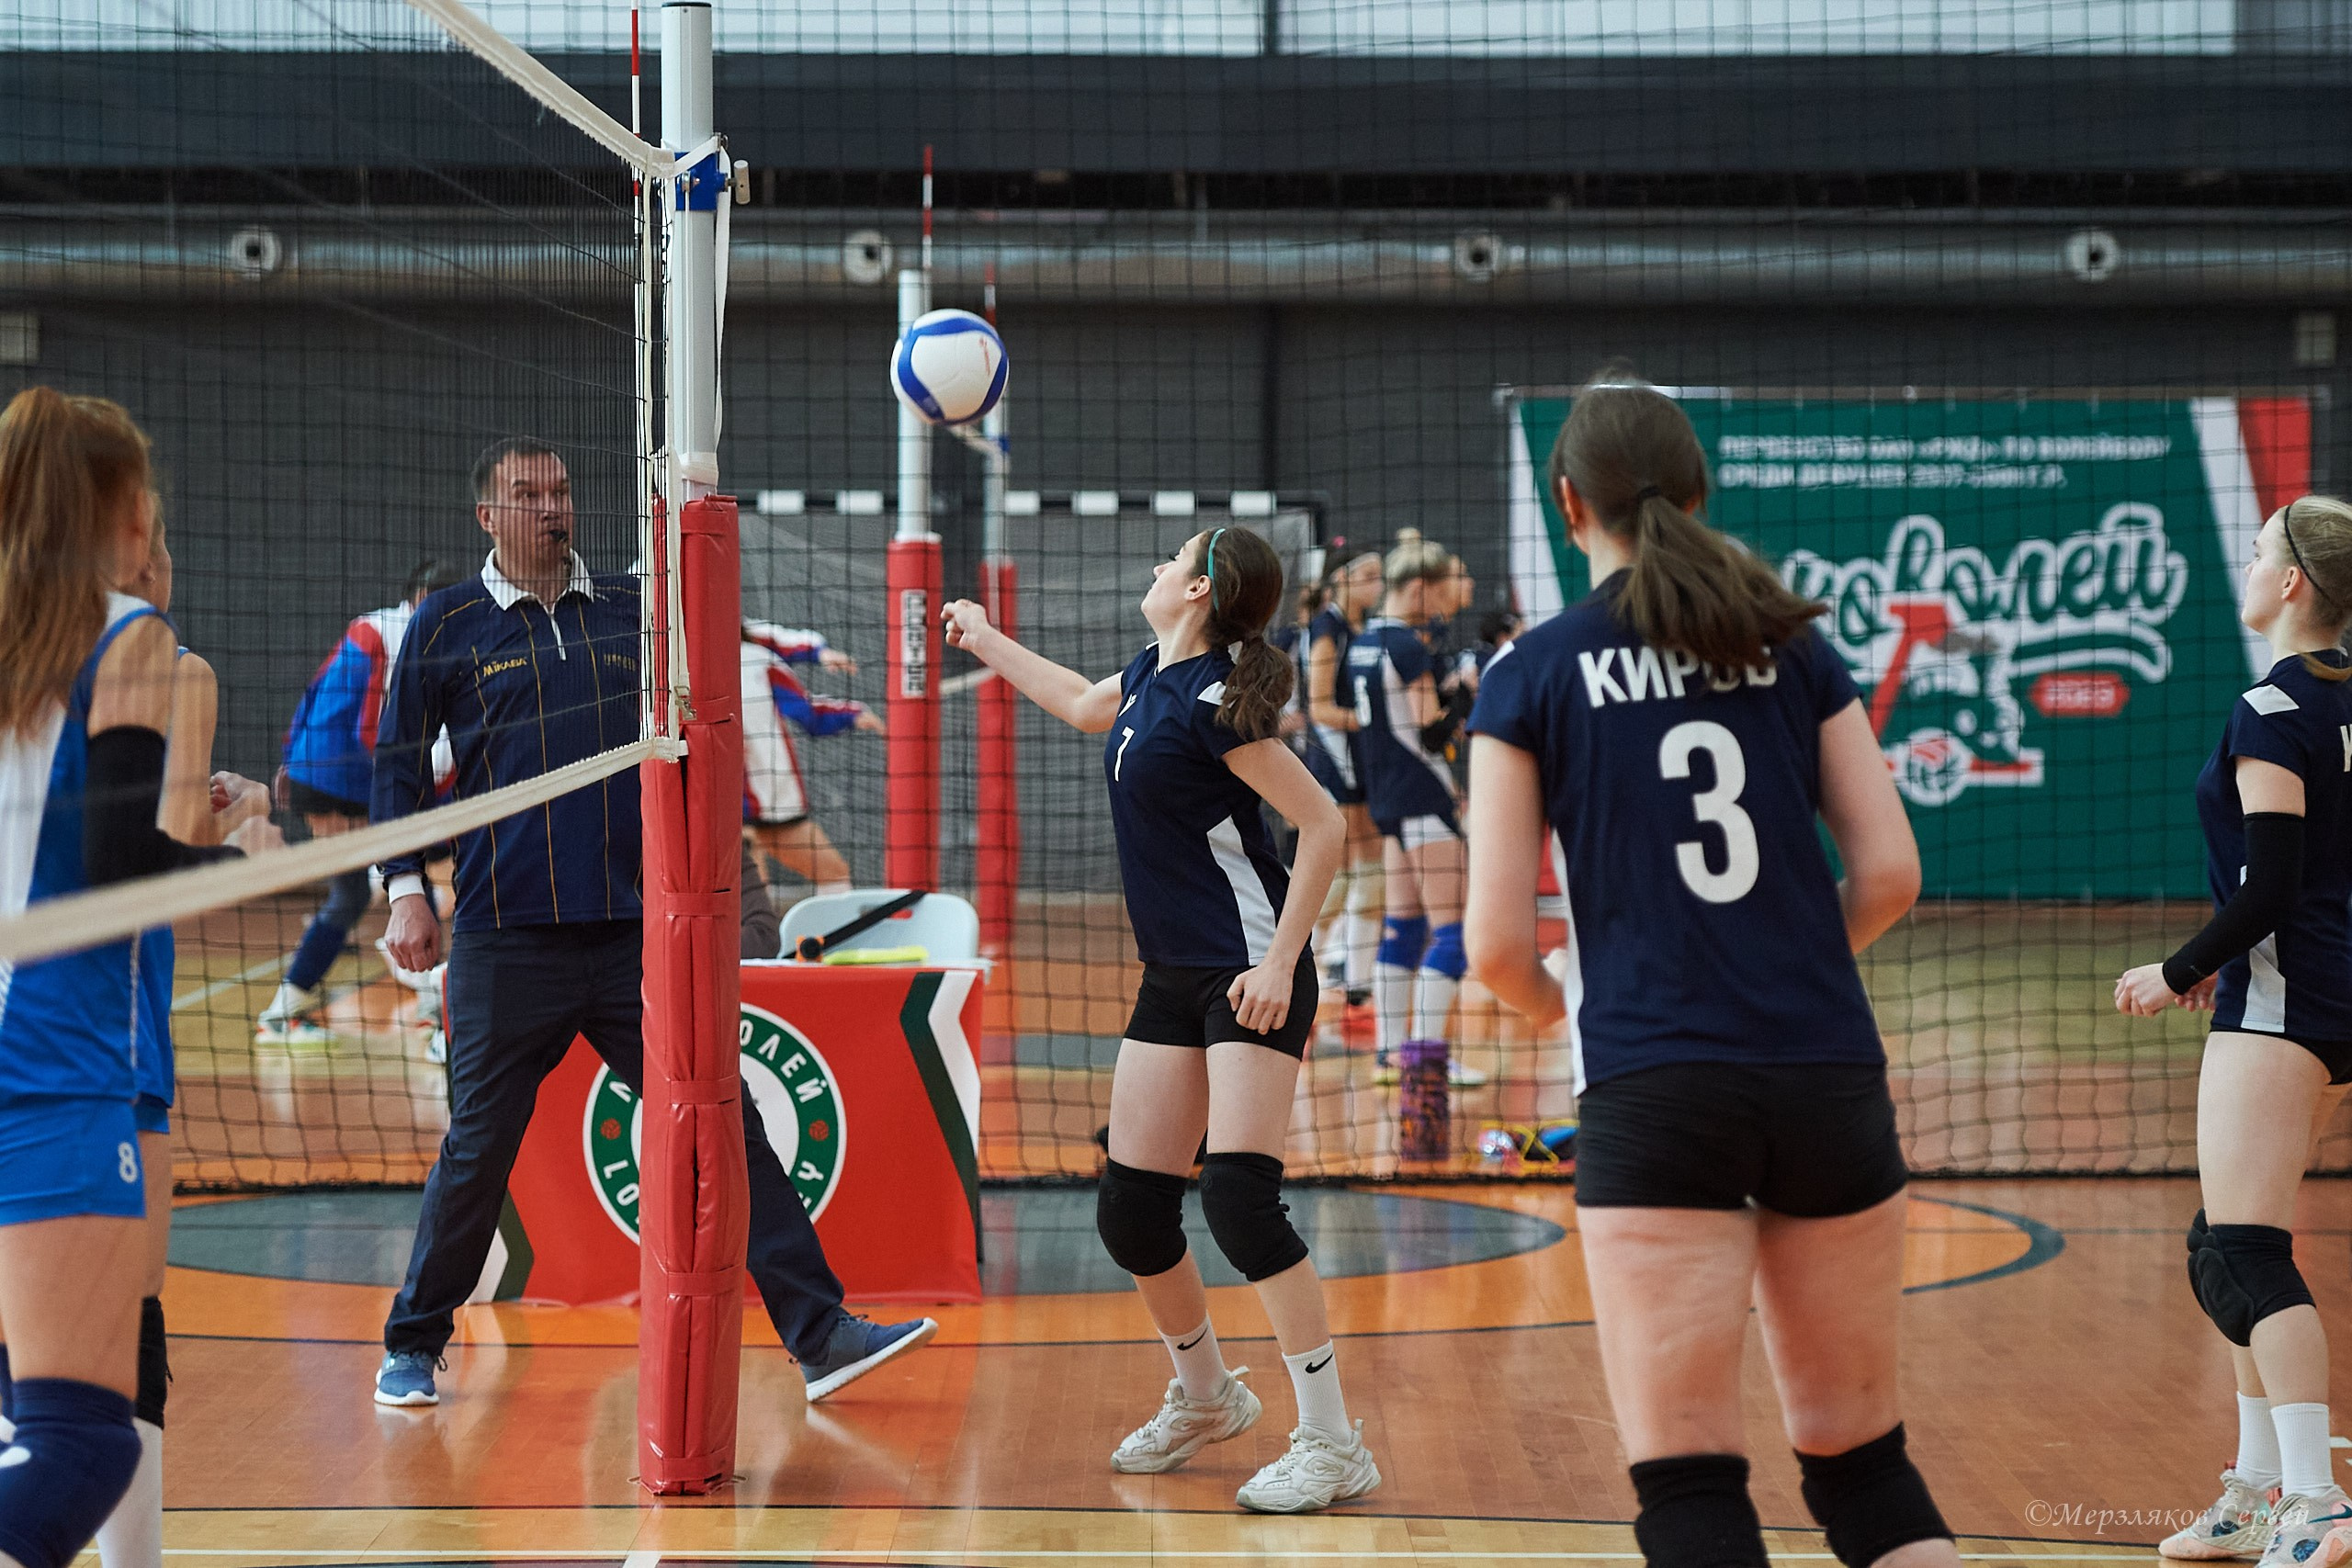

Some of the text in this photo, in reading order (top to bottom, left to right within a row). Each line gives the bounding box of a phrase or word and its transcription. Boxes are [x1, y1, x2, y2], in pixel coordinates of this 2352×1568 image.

[1114, 727, 1135, 782] 7
[1659, 720, 1759, 904] 3
[118, 1141, 138, 1183] 8
